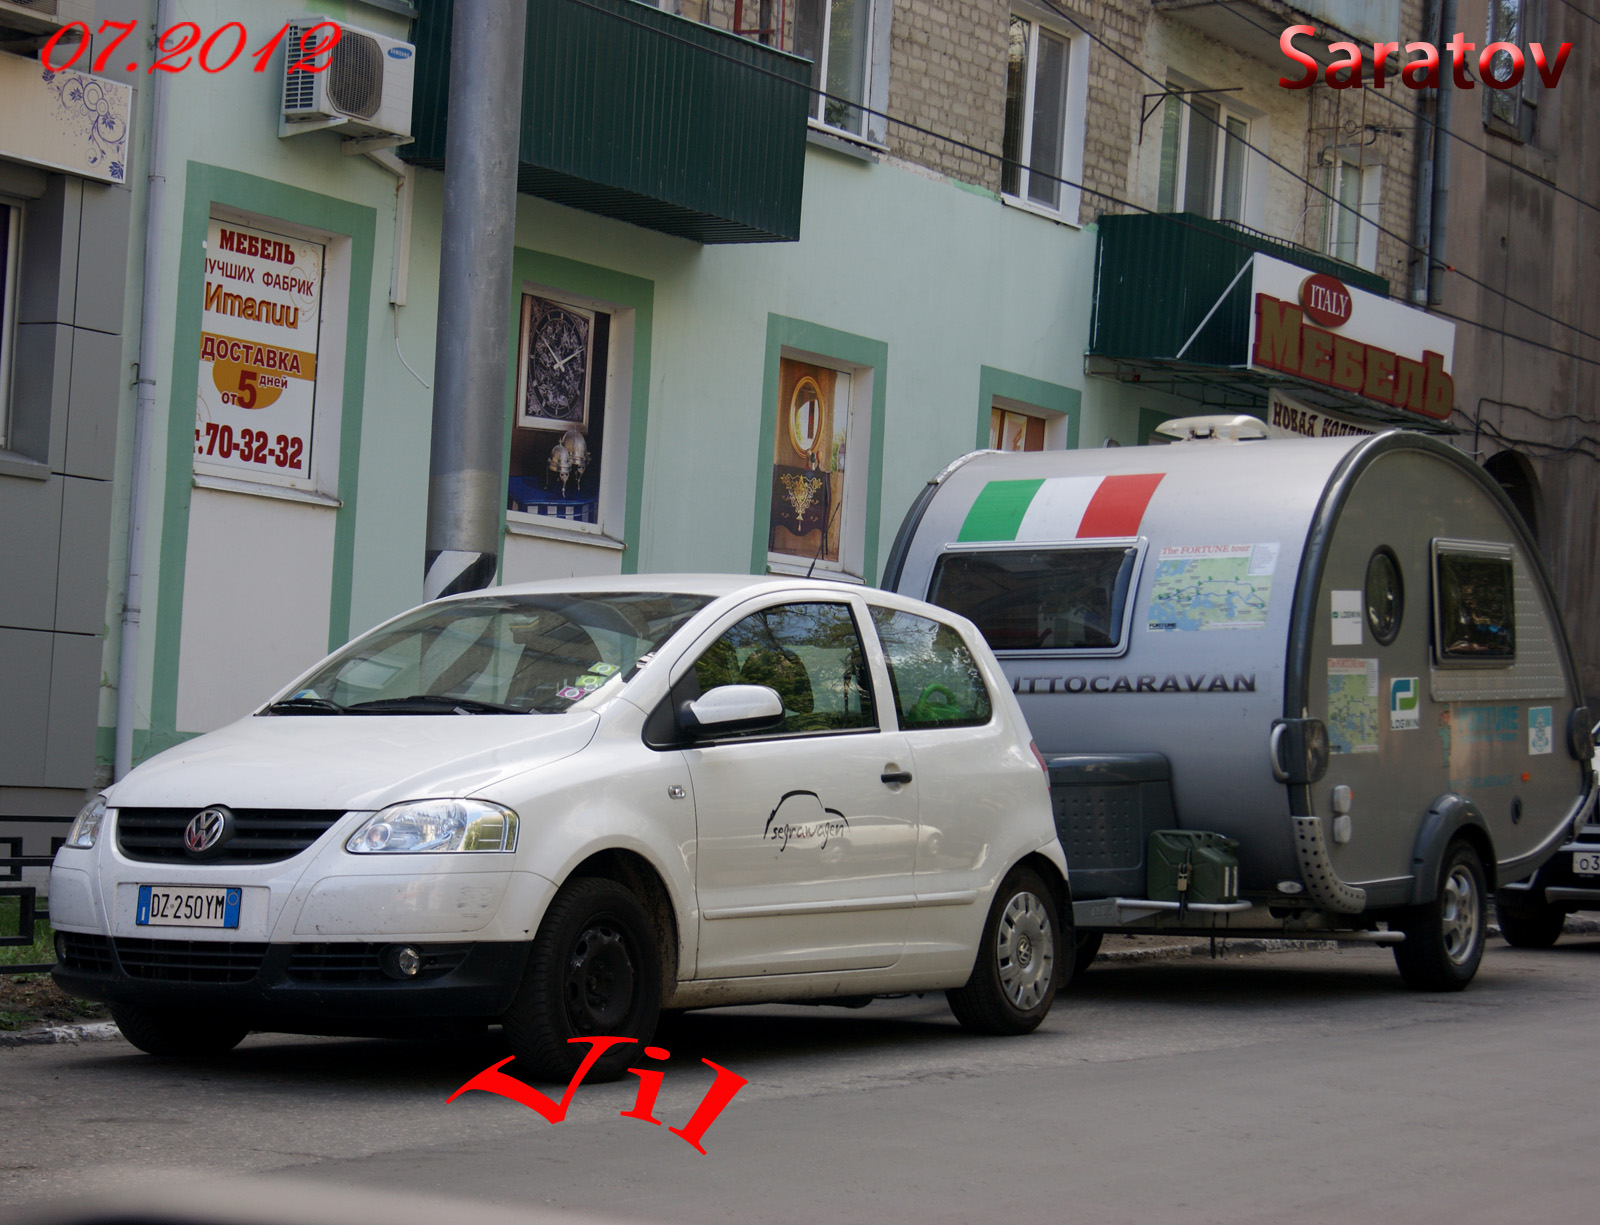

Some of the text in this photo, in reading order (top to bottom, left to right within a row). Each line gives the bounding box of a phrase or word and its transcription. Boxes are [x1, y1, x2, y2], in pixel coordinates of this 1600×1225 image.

[219, 228, 296, 265] МЕБЕЛЬ
[262, 271, 314, 297] ФАБРИК
[1310, 284, 1350, 318] ITALY
[204, 281, 299, 330] Италии
[201, 336, 301, 373] ДОСТАВКА
[221, 369, 288, 410] от 5 дней
[1273, 401, 1318, 437] НОВАЯ
[1162, 546, 1179, 555] The
[1180, 544, 1230, 554] FORTUNE
